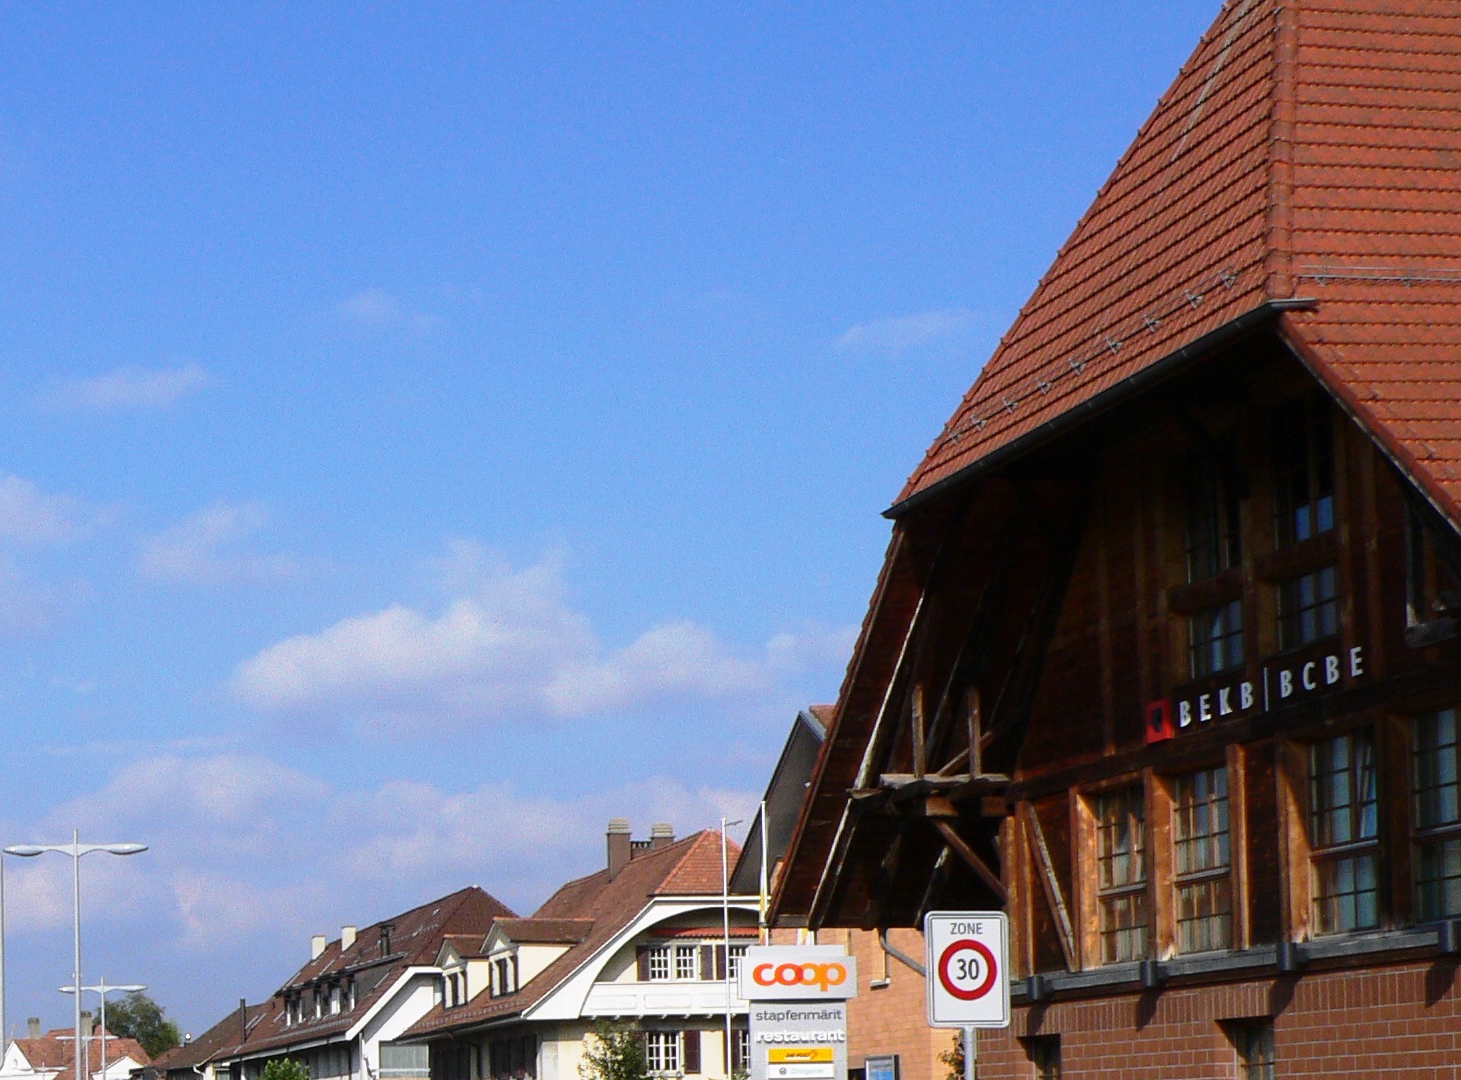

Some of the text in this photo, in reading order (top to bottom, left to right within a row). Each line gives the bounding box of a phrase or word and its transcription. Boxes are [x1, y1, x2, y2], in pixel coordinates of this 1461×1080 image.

[1178, 646, 1364, 728] BEKB BCBE
[950, 922, 983, 935] ZONE
[752, 963, 847, 992] coop
[956, 958, 980, 980] 30
[755, 1009, 843, 1022] stapfenmärit
[756, 1028, 846, 1042] restaurant
